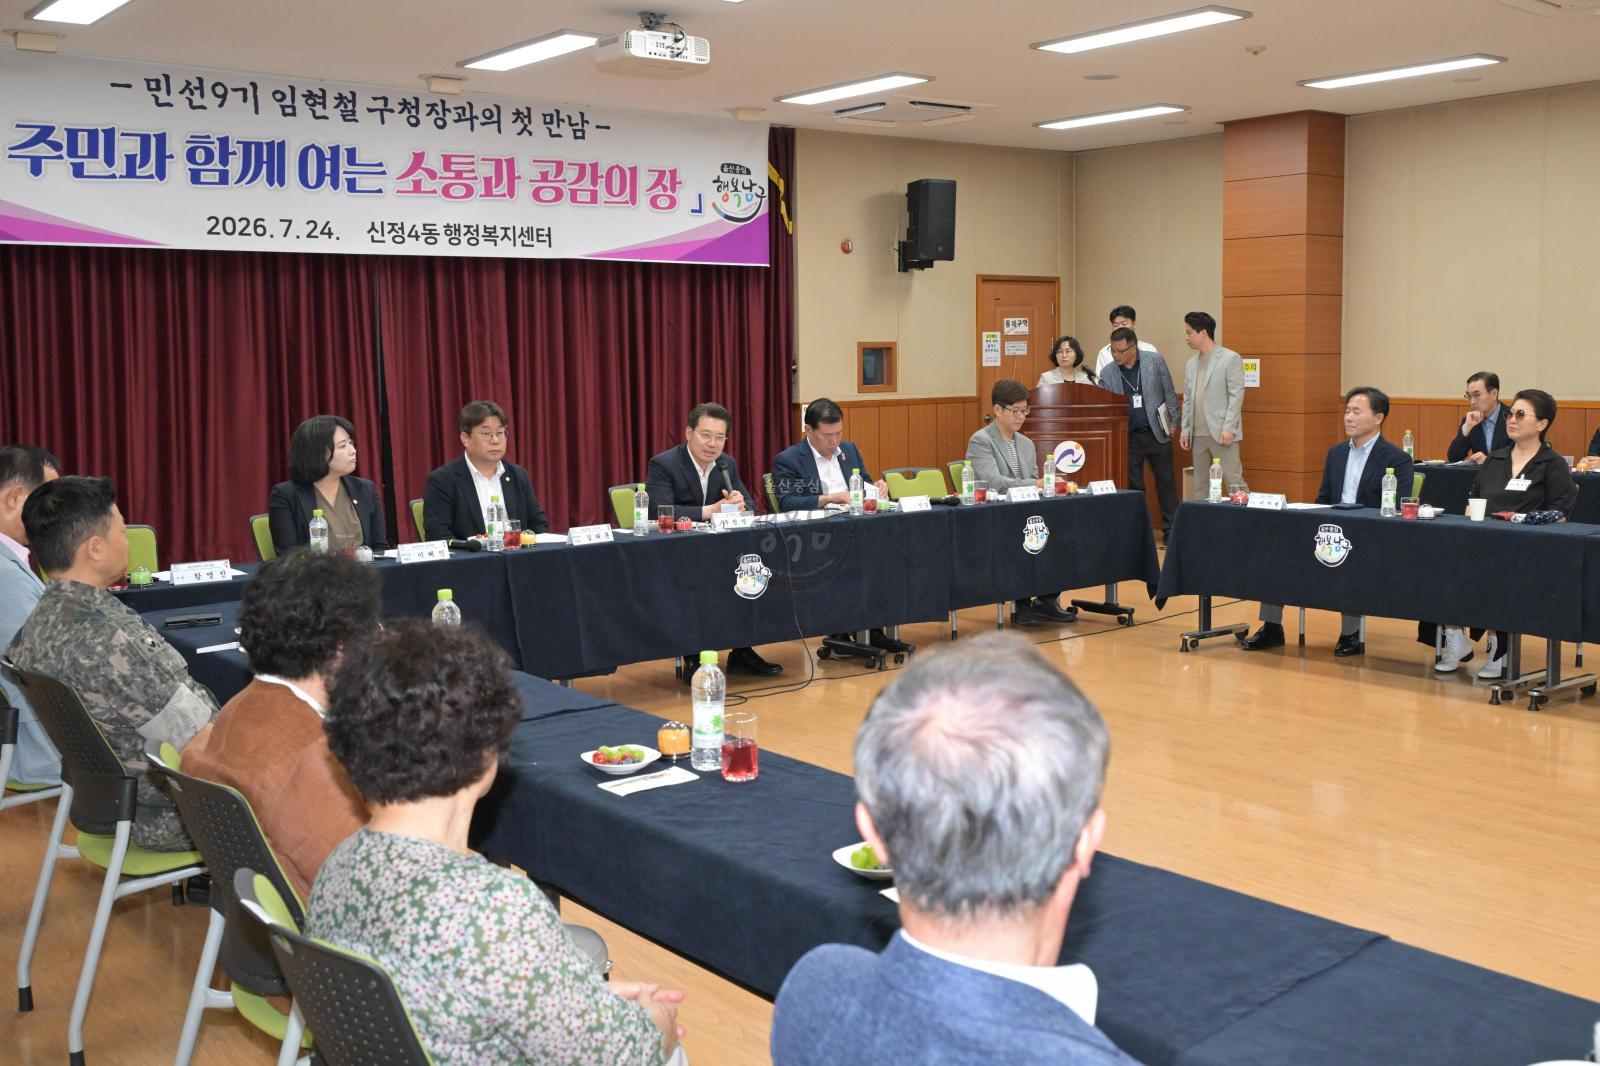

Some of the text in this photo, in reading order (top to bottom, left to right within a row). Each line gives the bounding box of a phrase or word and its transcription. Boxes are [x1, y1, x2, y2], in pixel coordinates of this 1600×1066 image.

[144, 73, 259, 115] 민선9기
[272, 85, 359, 123] 임현철
[367, 95, 502, 134] 구청장과의
[511, 106, 533, 137] 첫
[7, 123, 174, 182] 주민과
[185, 133, 287, 188] 함께
[298, 143, 388, 194] 여는
[395, 151, 522, 200] 소통과
[529, 158, 639, 207] 공감의
[712, 175, 767, 208] 행복남구
